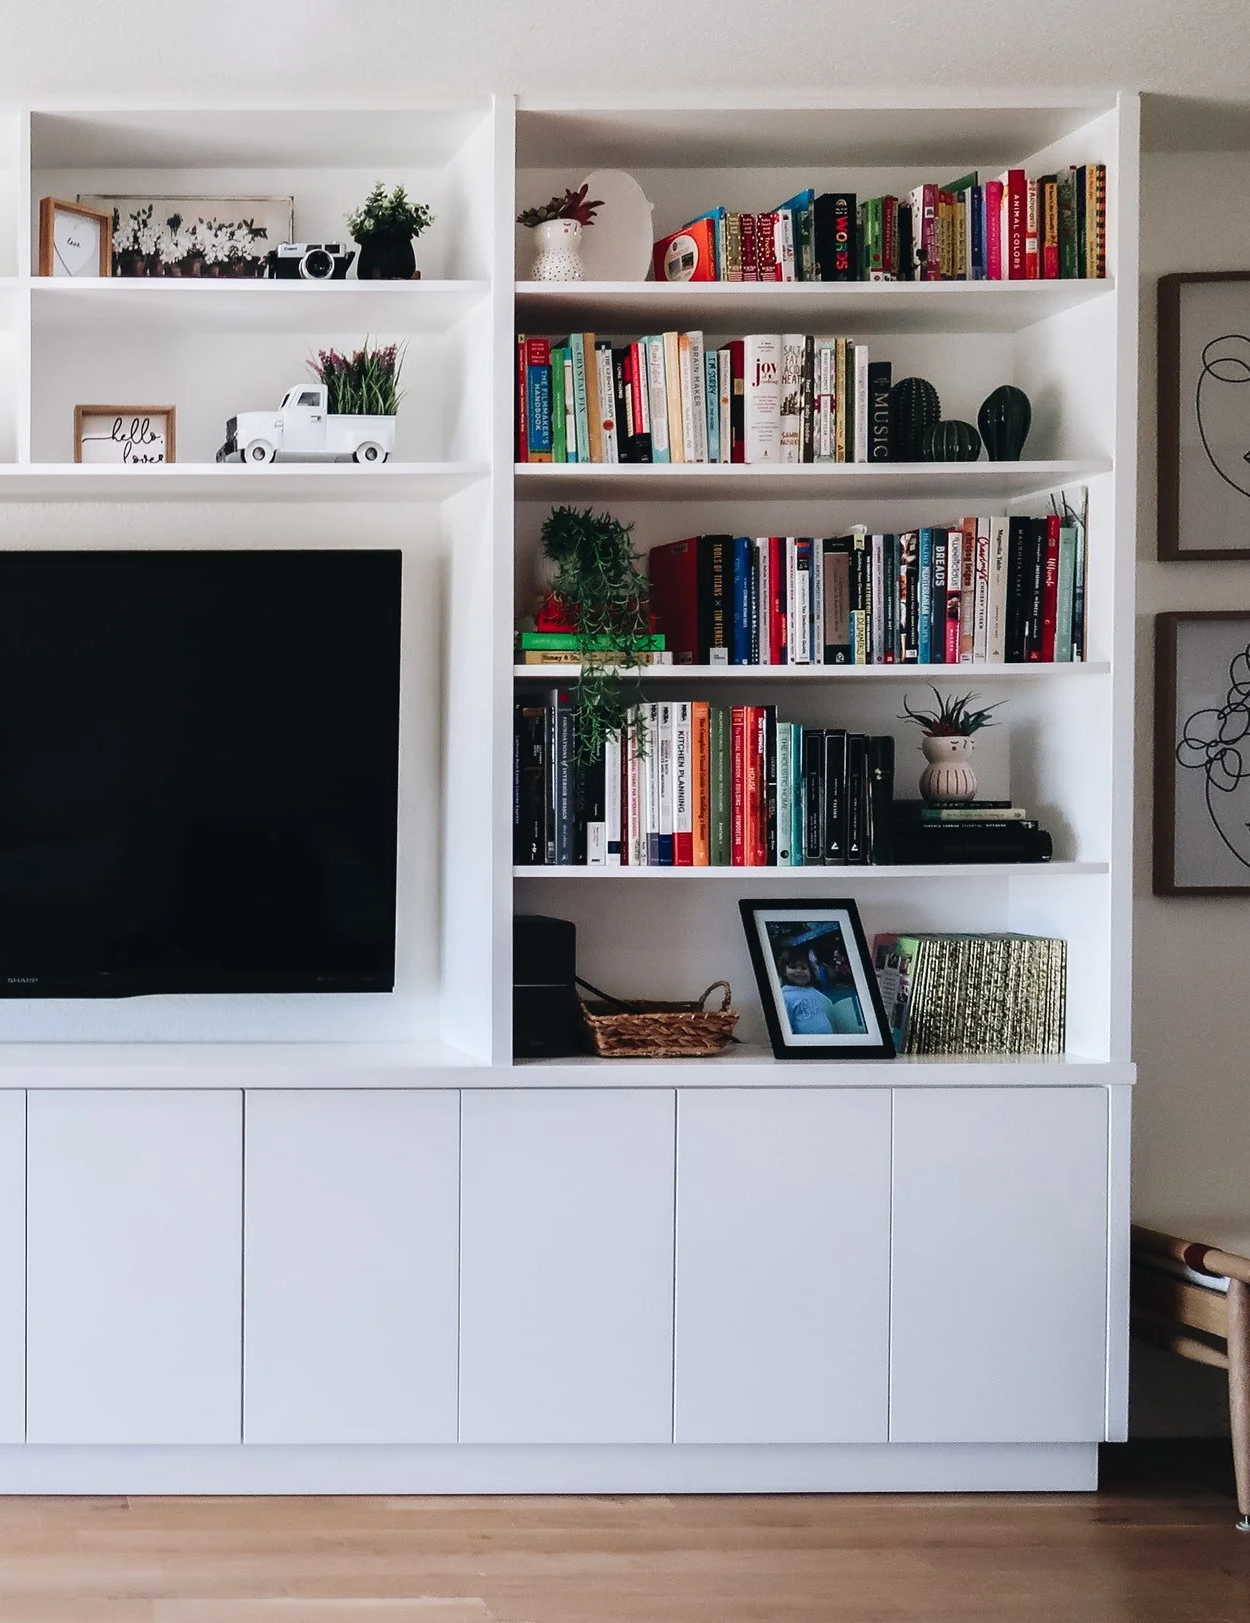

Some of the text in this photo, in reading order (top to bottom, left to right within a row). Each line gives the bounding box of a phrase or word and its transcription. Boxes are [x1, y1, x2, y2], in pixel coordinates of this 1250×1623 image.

[66, 237, 82, 248] love
[835, 216, 848, 270] WORDS
[783, 345, 801, 356] SALT
[785, 355, 799, 365] FAT
[576, 351, 586, 414] CRYSTAL FIX
[692, 346, 701, 407] BRAIN MAKER
[709, 371, 717, 395] SORRY
[752, 358, 779, 387] joy
[781, 374, 802, 385] HEAT
[540, 369, 549, 445] THE FILMMAKER'S
[803, 404, 811, 419] baby
[873, 392, 889, 458] MUSIC
[996, 529, 1004, 555] Magnolia
[713, 544, 722, 596] TOOLS OF TITANS
[935, 546, 945, 587] BREADS
[951, 536, 962, 587] weelicious
[963, 532, 974, 587] chrissy teigen
[976, 536, 990, 581] Cravings
[921, 566, 931, 615] MEDITERRANEAN
[714, 609, 723, 649] TIM FERRISS
[542, 654, 562, 662] Honey
[677, 730, 685, 768] KITCHEN
[698, 728, 706, 754] Complete
[734, 735, 742, 752] VISUAL
[734, 752, 742, 778] HANDBOOK
[698, 796, 706, 819] Building
[6, 976, 39, 984] SHARP
